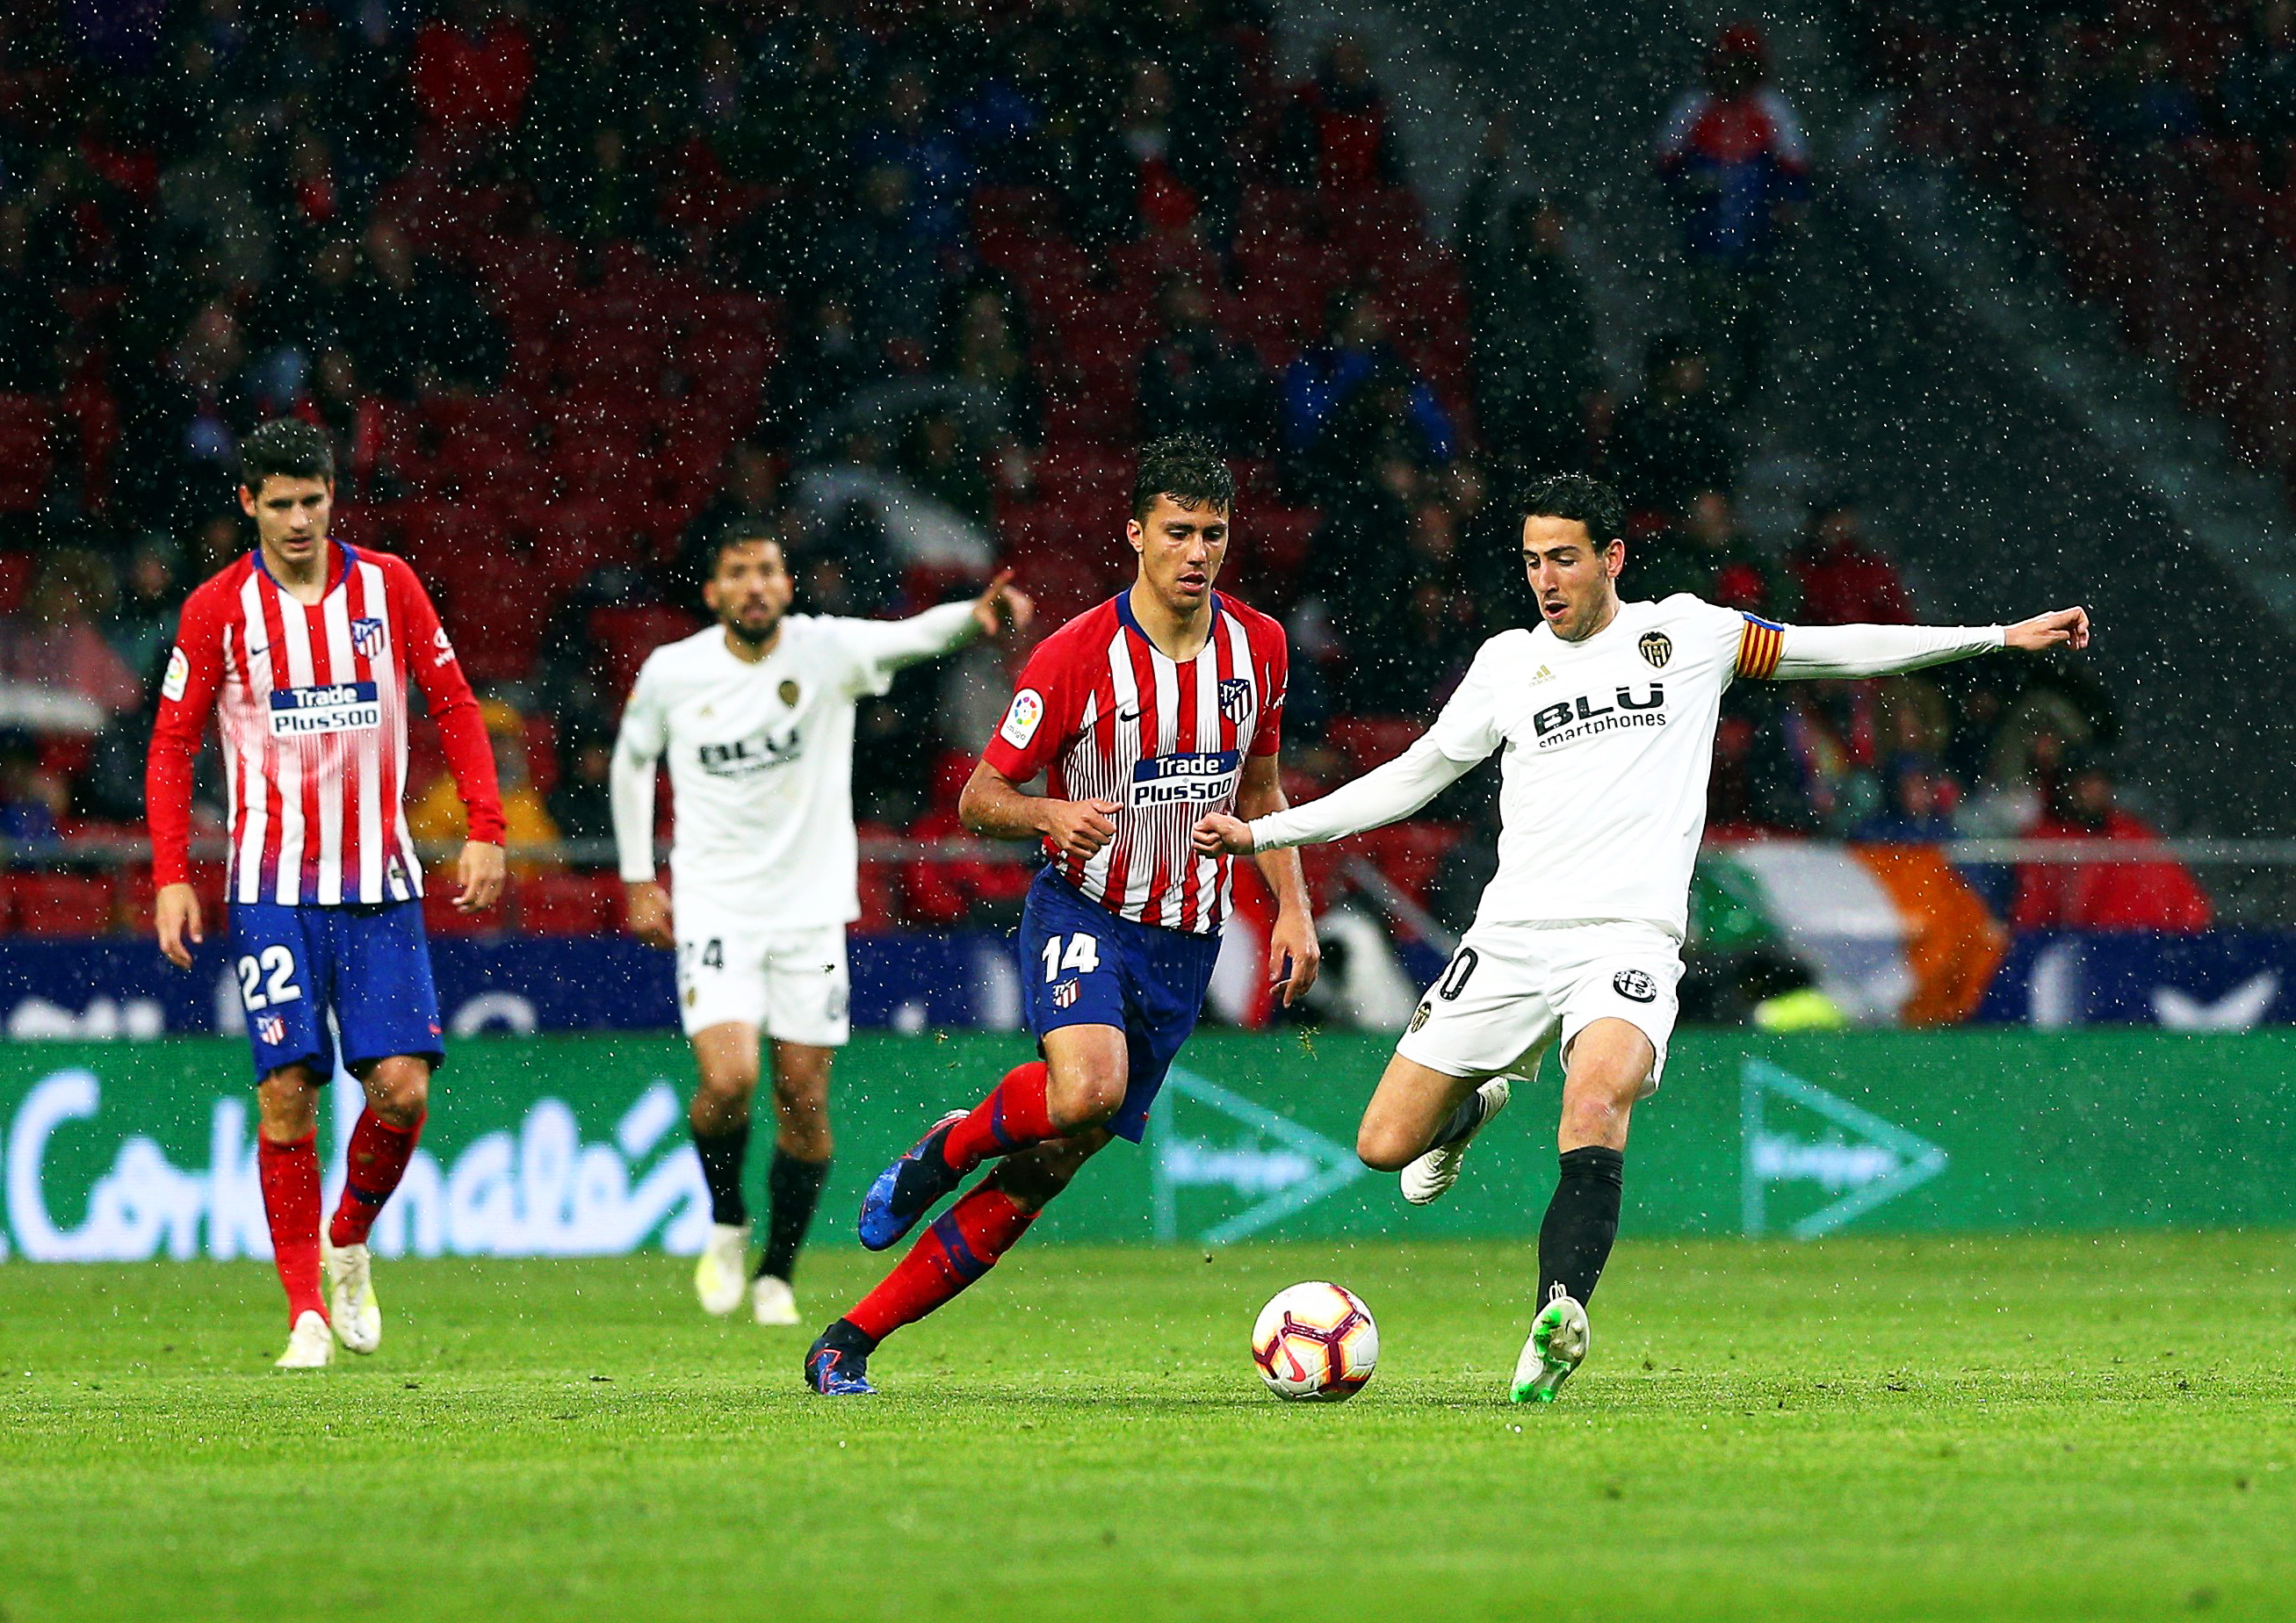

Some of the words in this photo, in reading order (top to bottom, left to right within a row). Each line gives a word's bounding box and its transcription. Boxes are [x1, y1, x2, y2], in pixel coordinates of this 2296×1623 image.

[292, 684, 358, 708] Trade
[1534, 682, 1664, 738] BLU
[275, 709, 378, 732] Plus500
[1539, 713, 1666, 748] smartphones
[1155, 754, 1220, 776] Trade
[1134, 776, 1232, 805] Plus500
[1042, 932, 1100, 984] 14
[238, 944, 302, 1013] 22
